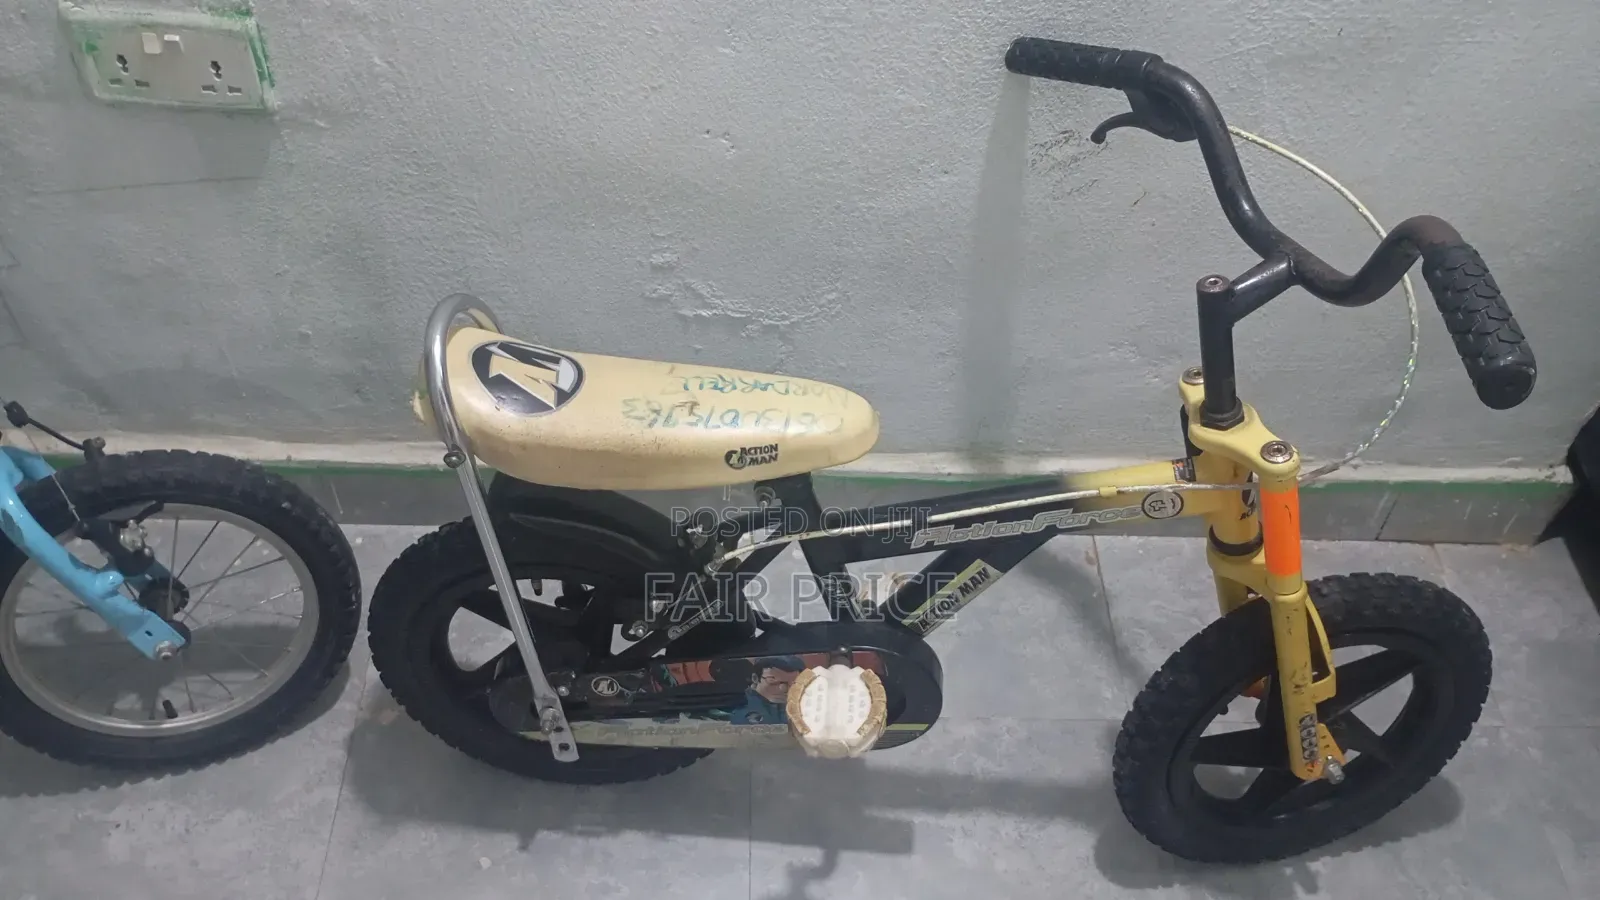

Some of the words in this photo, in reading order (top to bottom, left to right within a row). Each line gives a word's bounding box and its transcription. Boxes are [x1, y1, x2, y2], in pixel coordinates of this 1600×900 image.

[740, 443, 778, 456] ACTION
[748, 453, 778, 466] MAN
[910, 505, 1144, 549] ActionForce
[918, 591, 961, 632] ACTION
[958, 566, 991, 598] MAN
